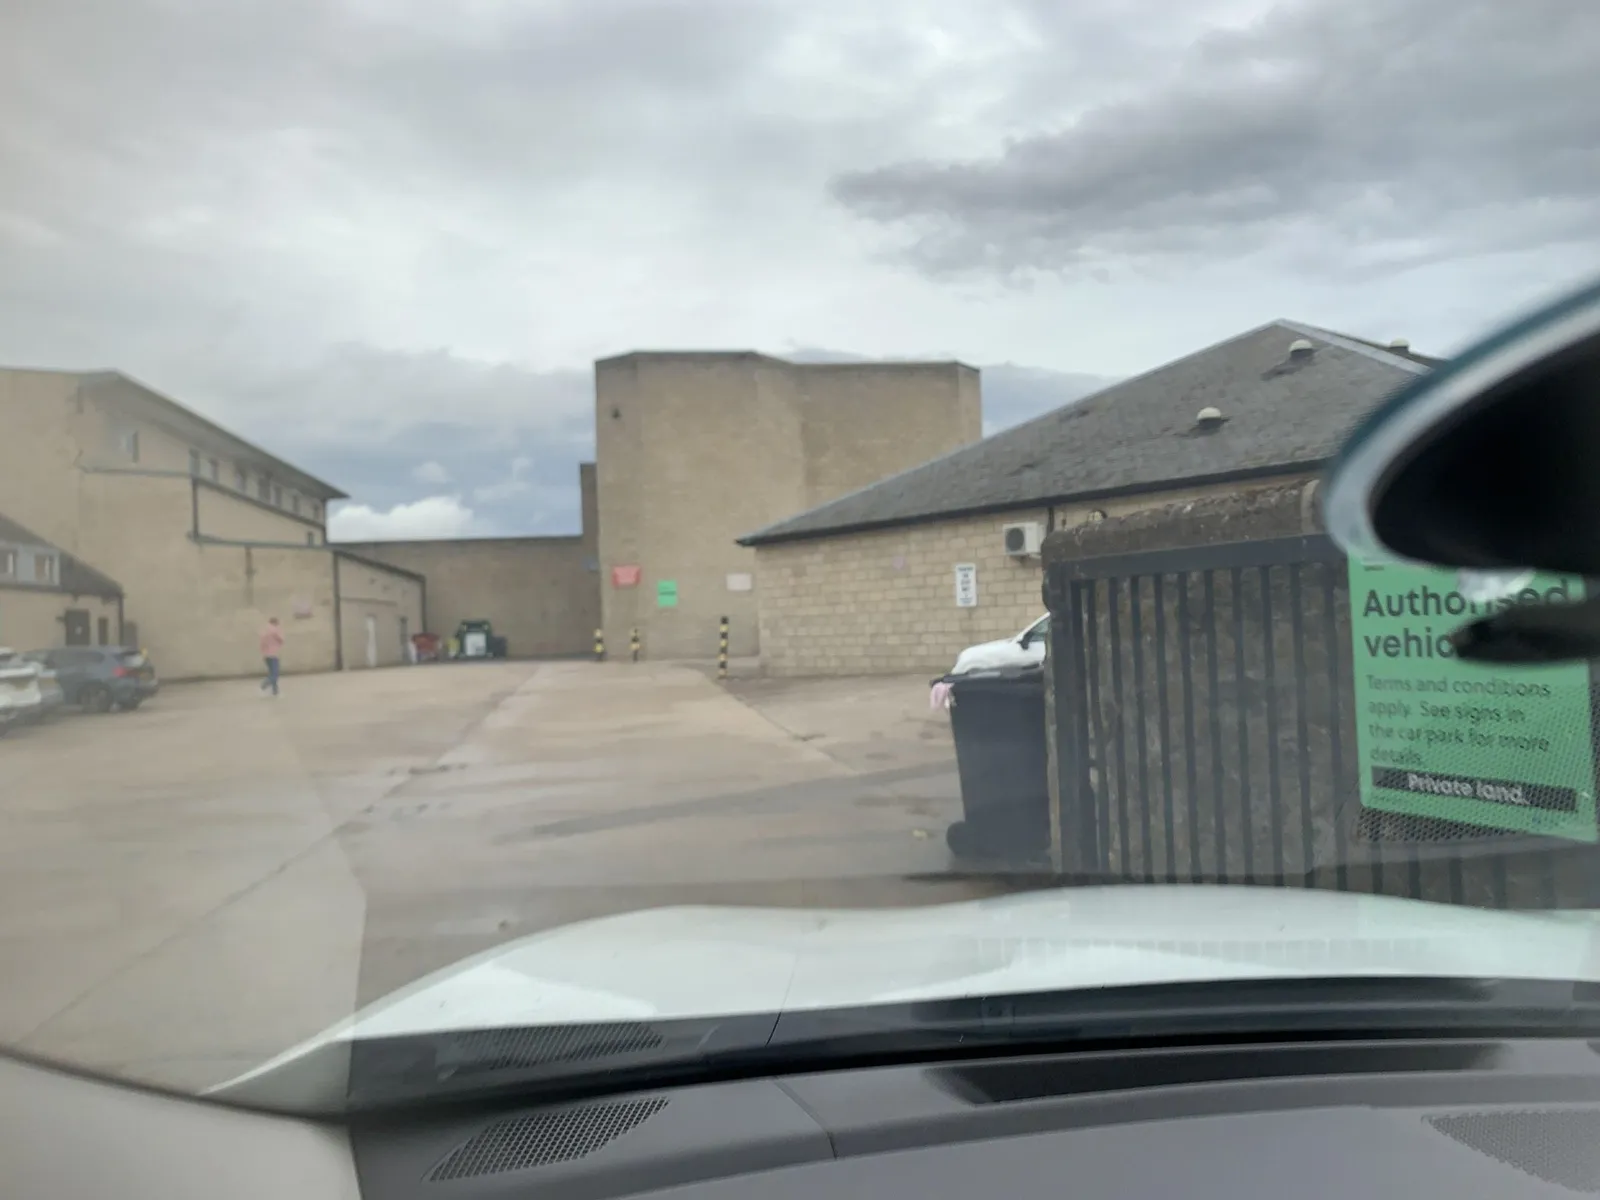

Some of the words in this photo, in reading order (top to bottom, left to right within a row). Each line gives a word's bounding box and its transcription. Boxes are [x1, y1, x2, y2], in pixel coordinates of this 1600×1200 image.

[1364, 626, 1455, 658] vehic
[1366, 674, 1411, 692] Terms
[1416, 677, 1448, 693] and
[1452, 678, 1551, 697] conditions
[1419, 701, 1451, 718] See
[1455, 704, 1501, 726] signs
[1368, 723, 1394, 739] the
[1397, 728, 1422, 742] car
[1424, 729, 1464, 748] park
[1499, 734, 1551, 752] more
[1408, 772, 1473, 797] Private
